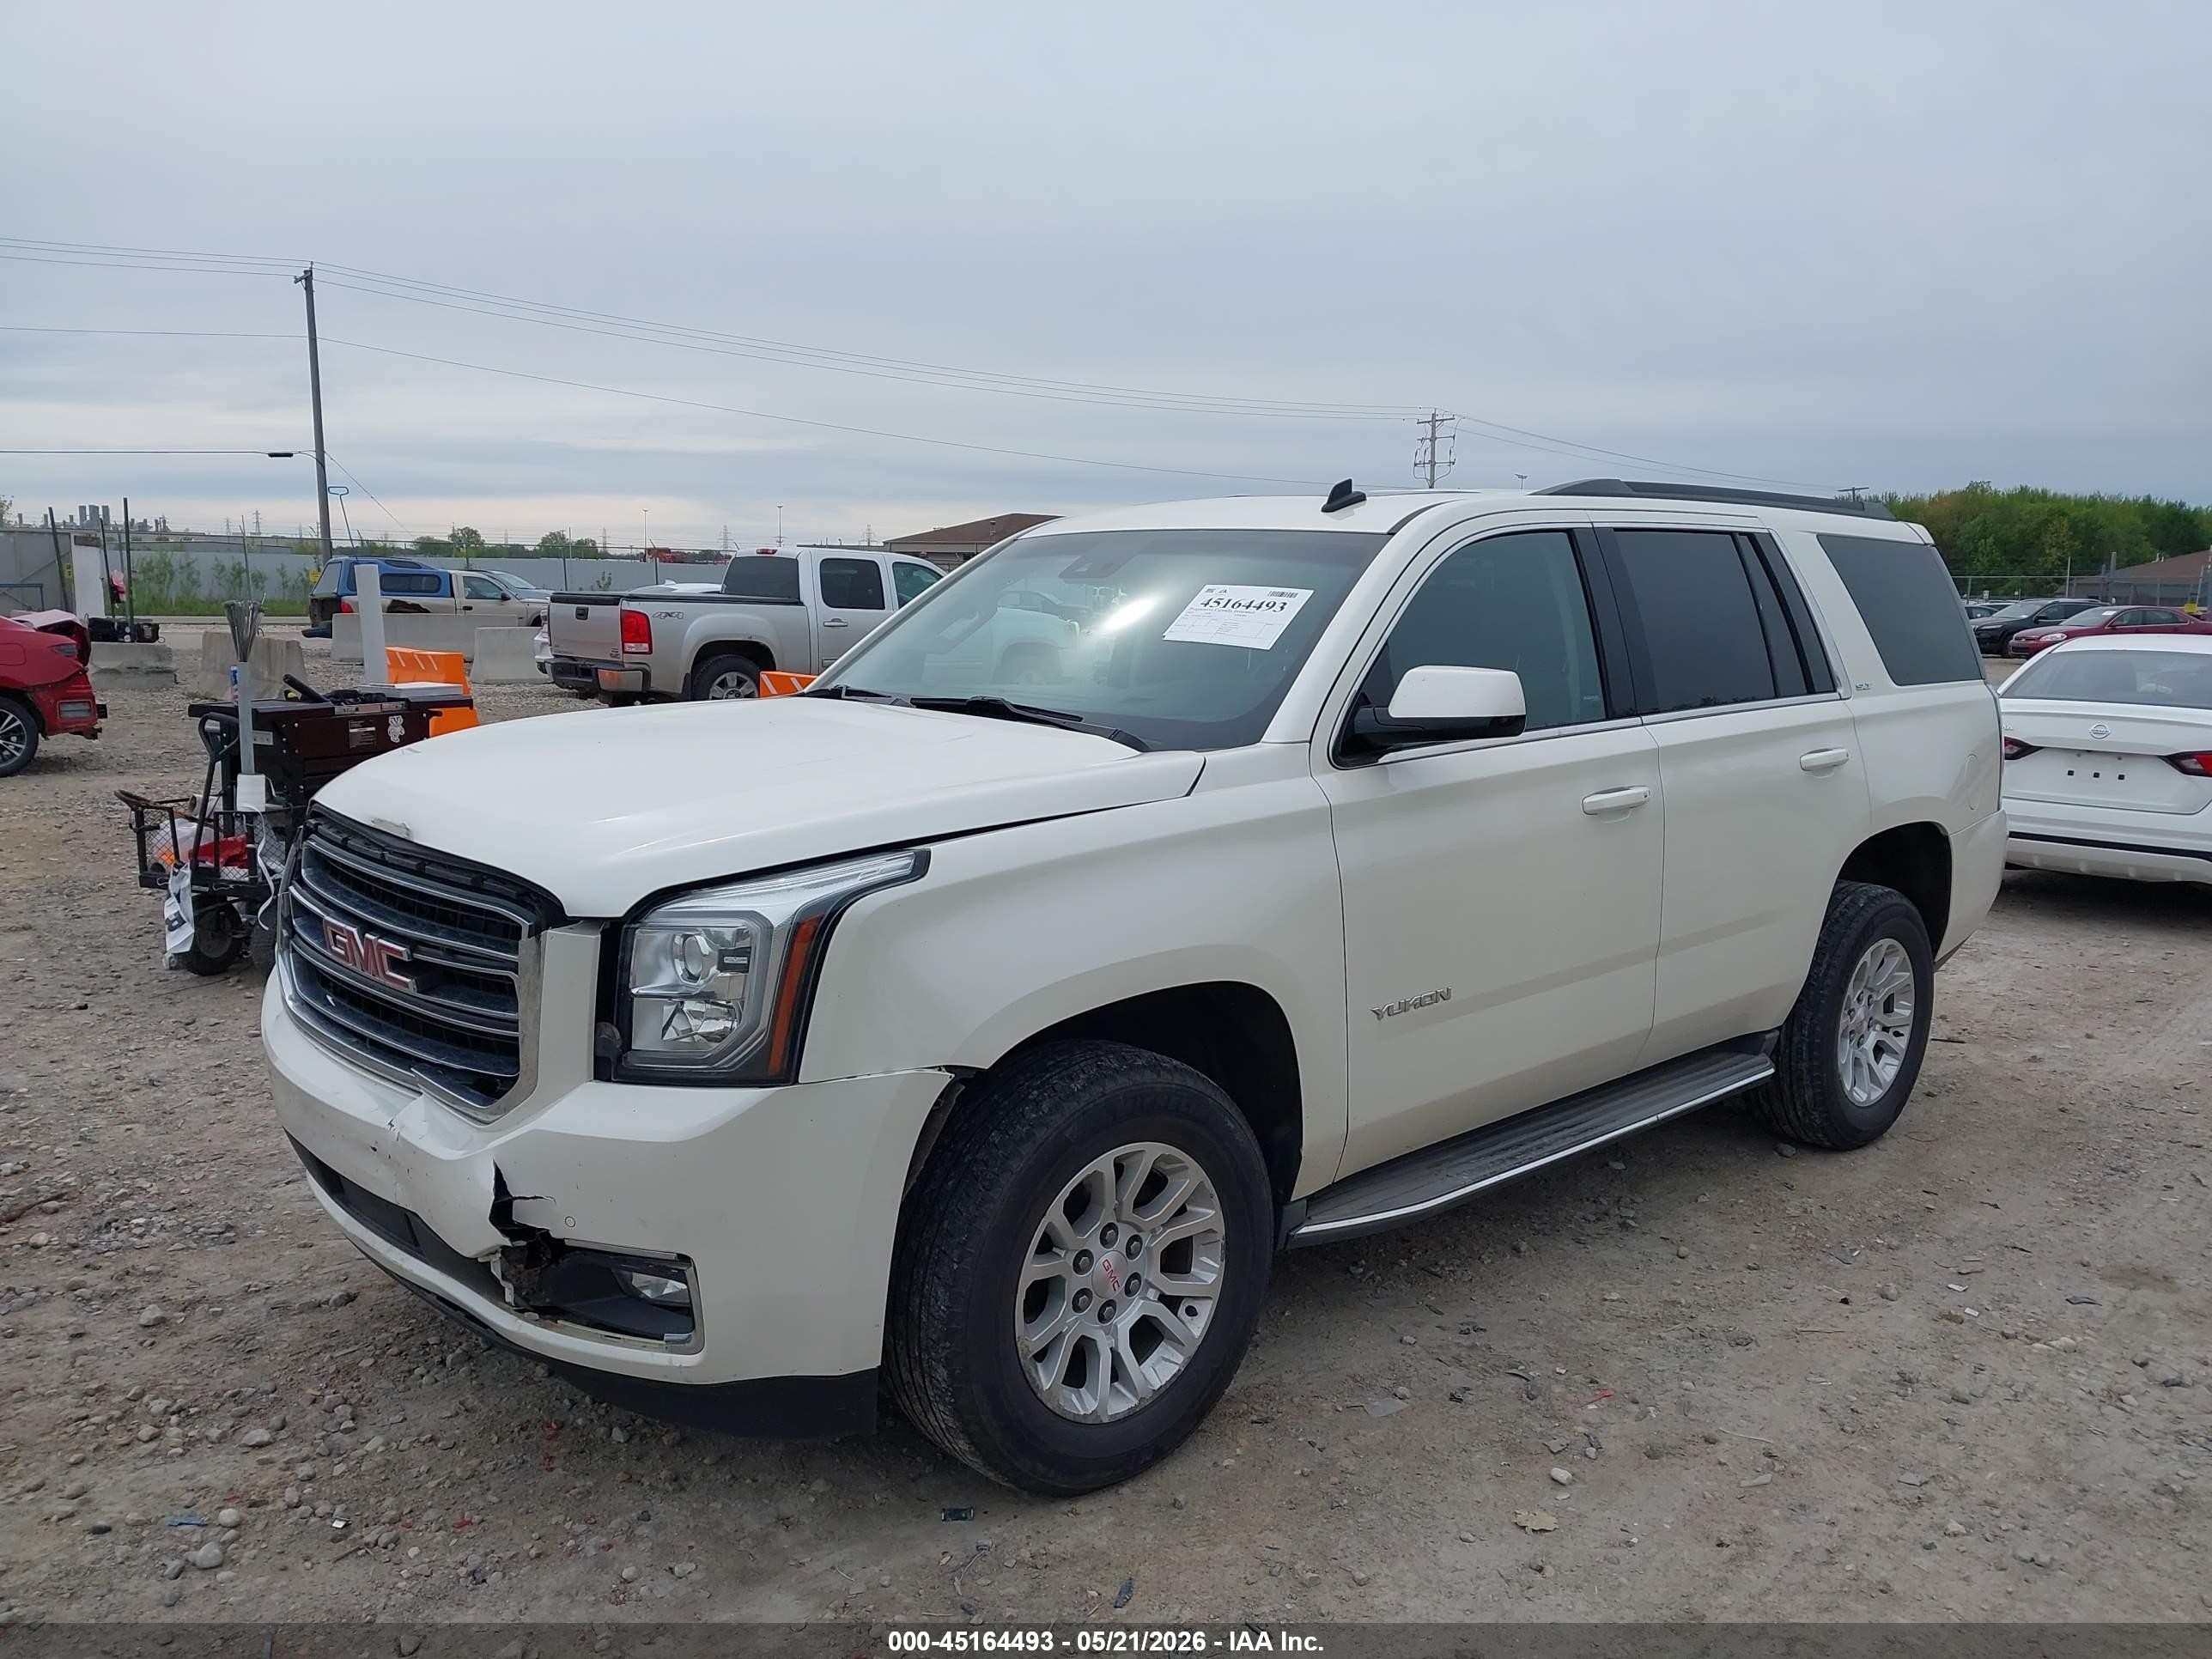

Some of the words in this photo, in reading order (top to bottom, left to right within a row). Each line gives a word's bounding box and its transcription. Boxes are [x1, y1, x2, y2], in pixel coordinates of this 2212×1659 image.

[1200, 598, 1287, 612] 45164493
[323, 916, 417, 993] GMC
[1370, 988, 1452, 1020] YUKON
[1102, 1259, 1120, 1291] GMC
